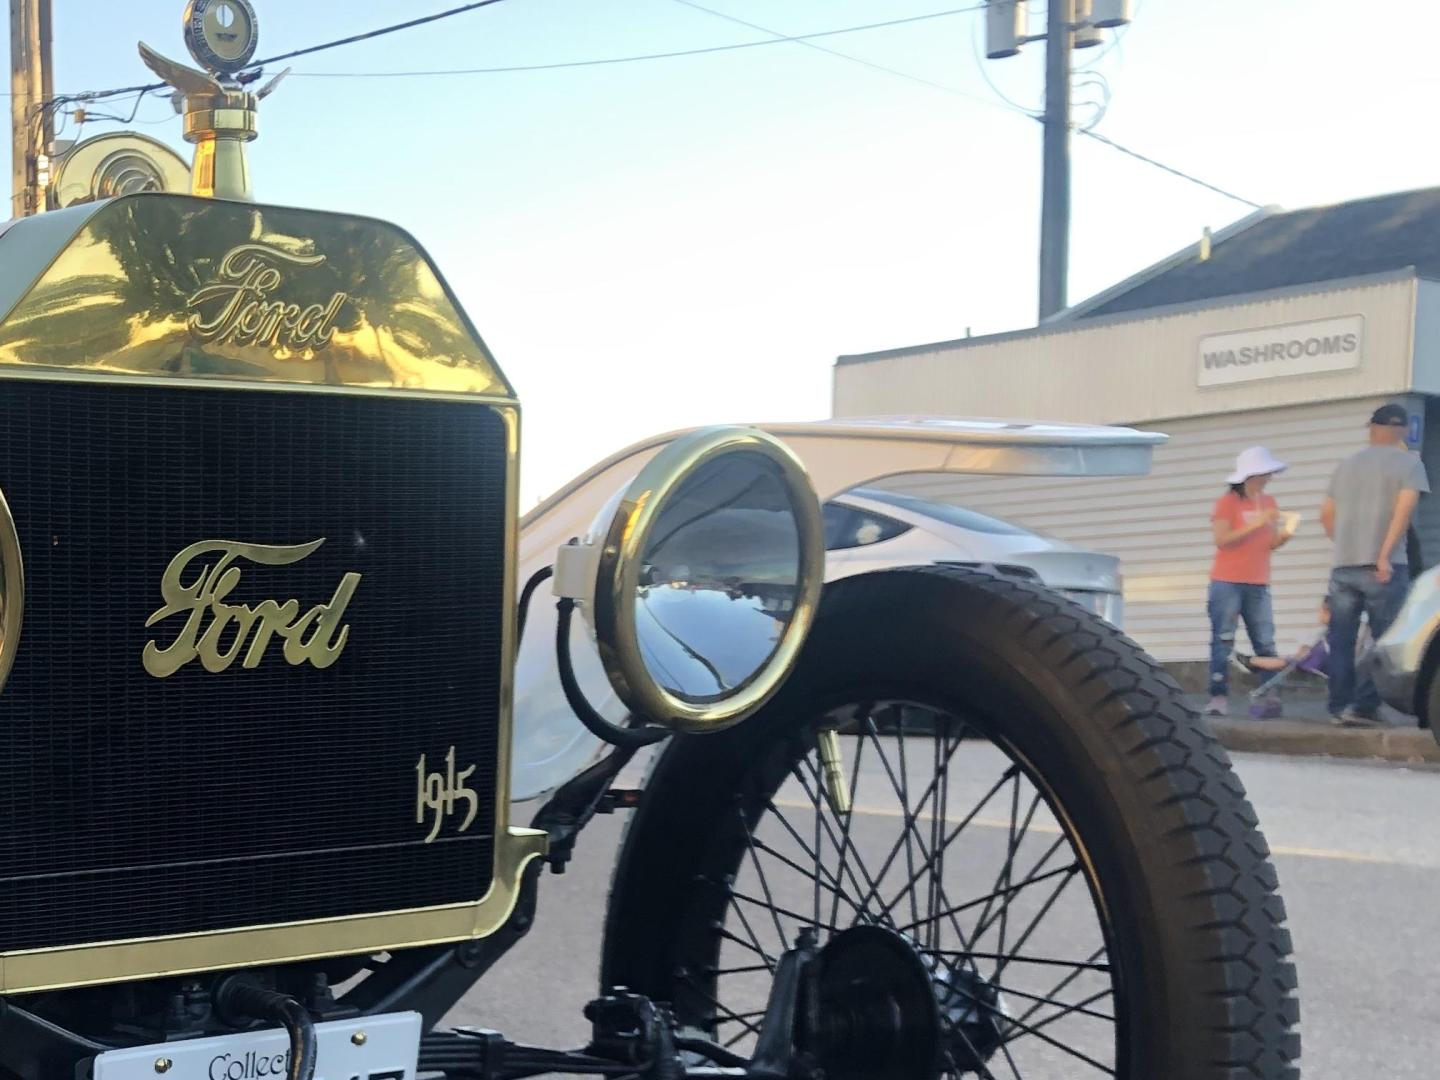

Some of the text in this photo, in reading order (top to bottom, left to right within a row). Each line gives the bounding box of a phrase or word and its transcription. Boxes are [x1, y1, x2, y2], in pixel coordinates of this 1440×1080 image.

[186, 244, 348, 347] Ford
[1203, 333, 1357, 370] WASHROOMS
[142, 537, 362, 678] Ford
[415, 745, 479, 843] 1915
